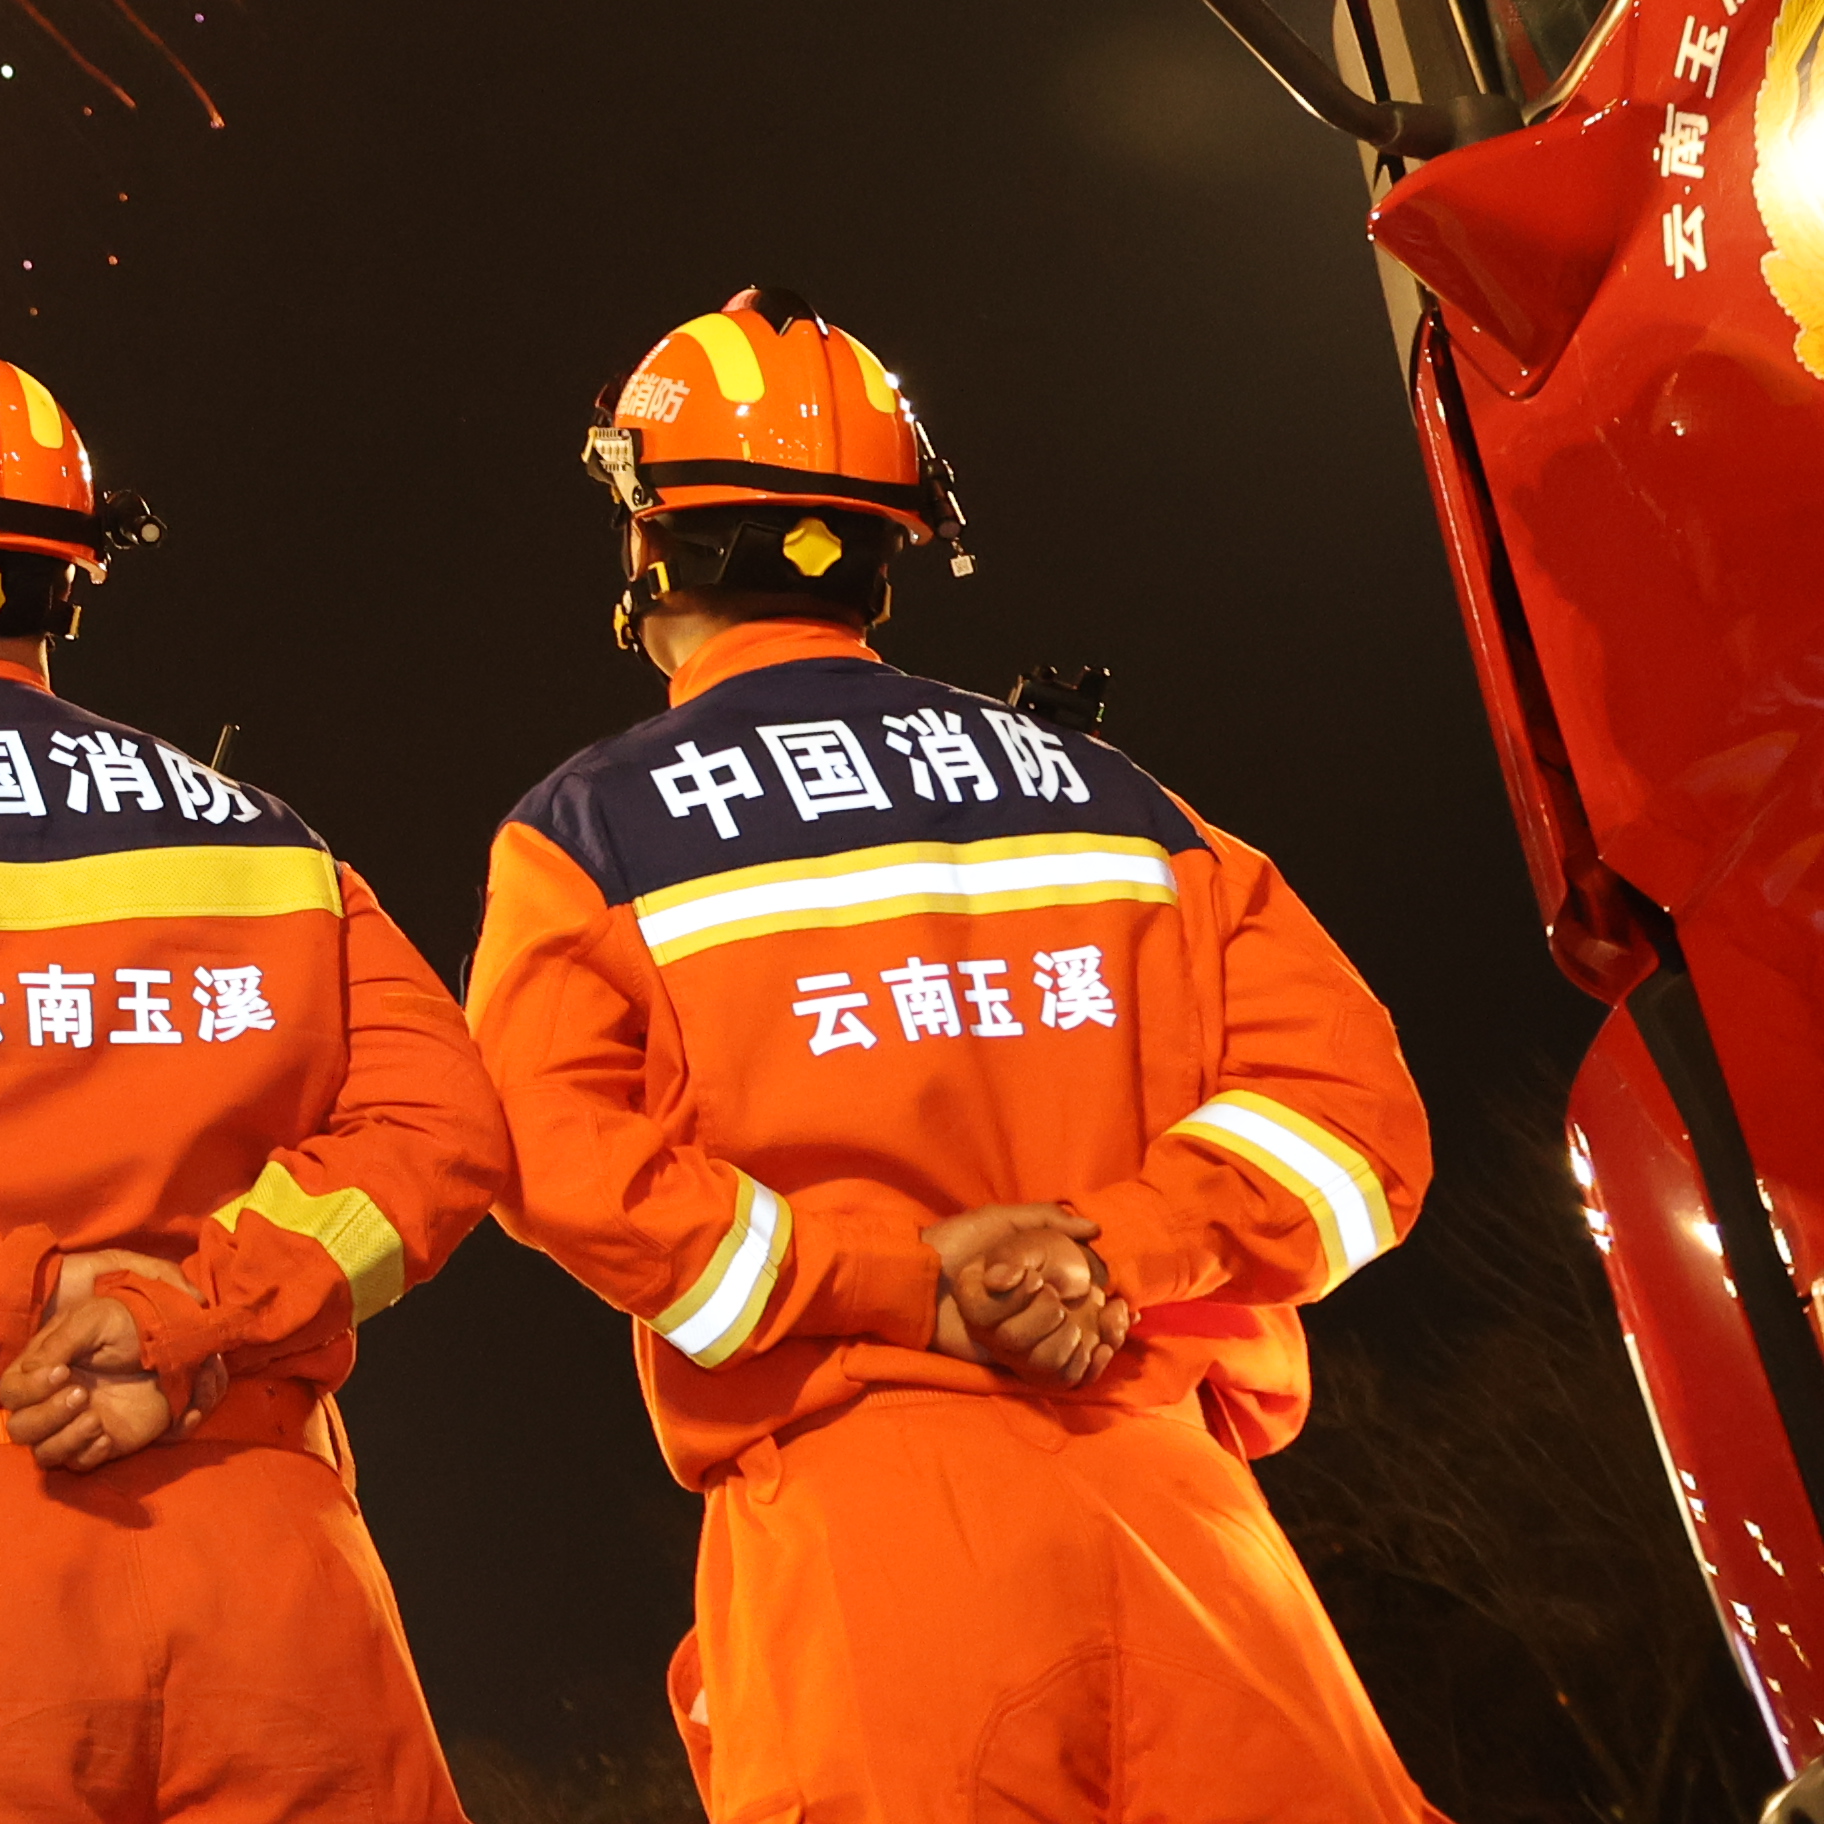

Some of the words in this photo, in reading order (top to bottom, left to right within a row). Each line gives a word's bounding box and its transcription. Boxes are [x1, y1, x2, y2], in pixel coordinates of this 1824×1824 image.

[649, 708, 1091, 840] 中国消防
[792, 944, 1118, 1057] 云南玉溪
